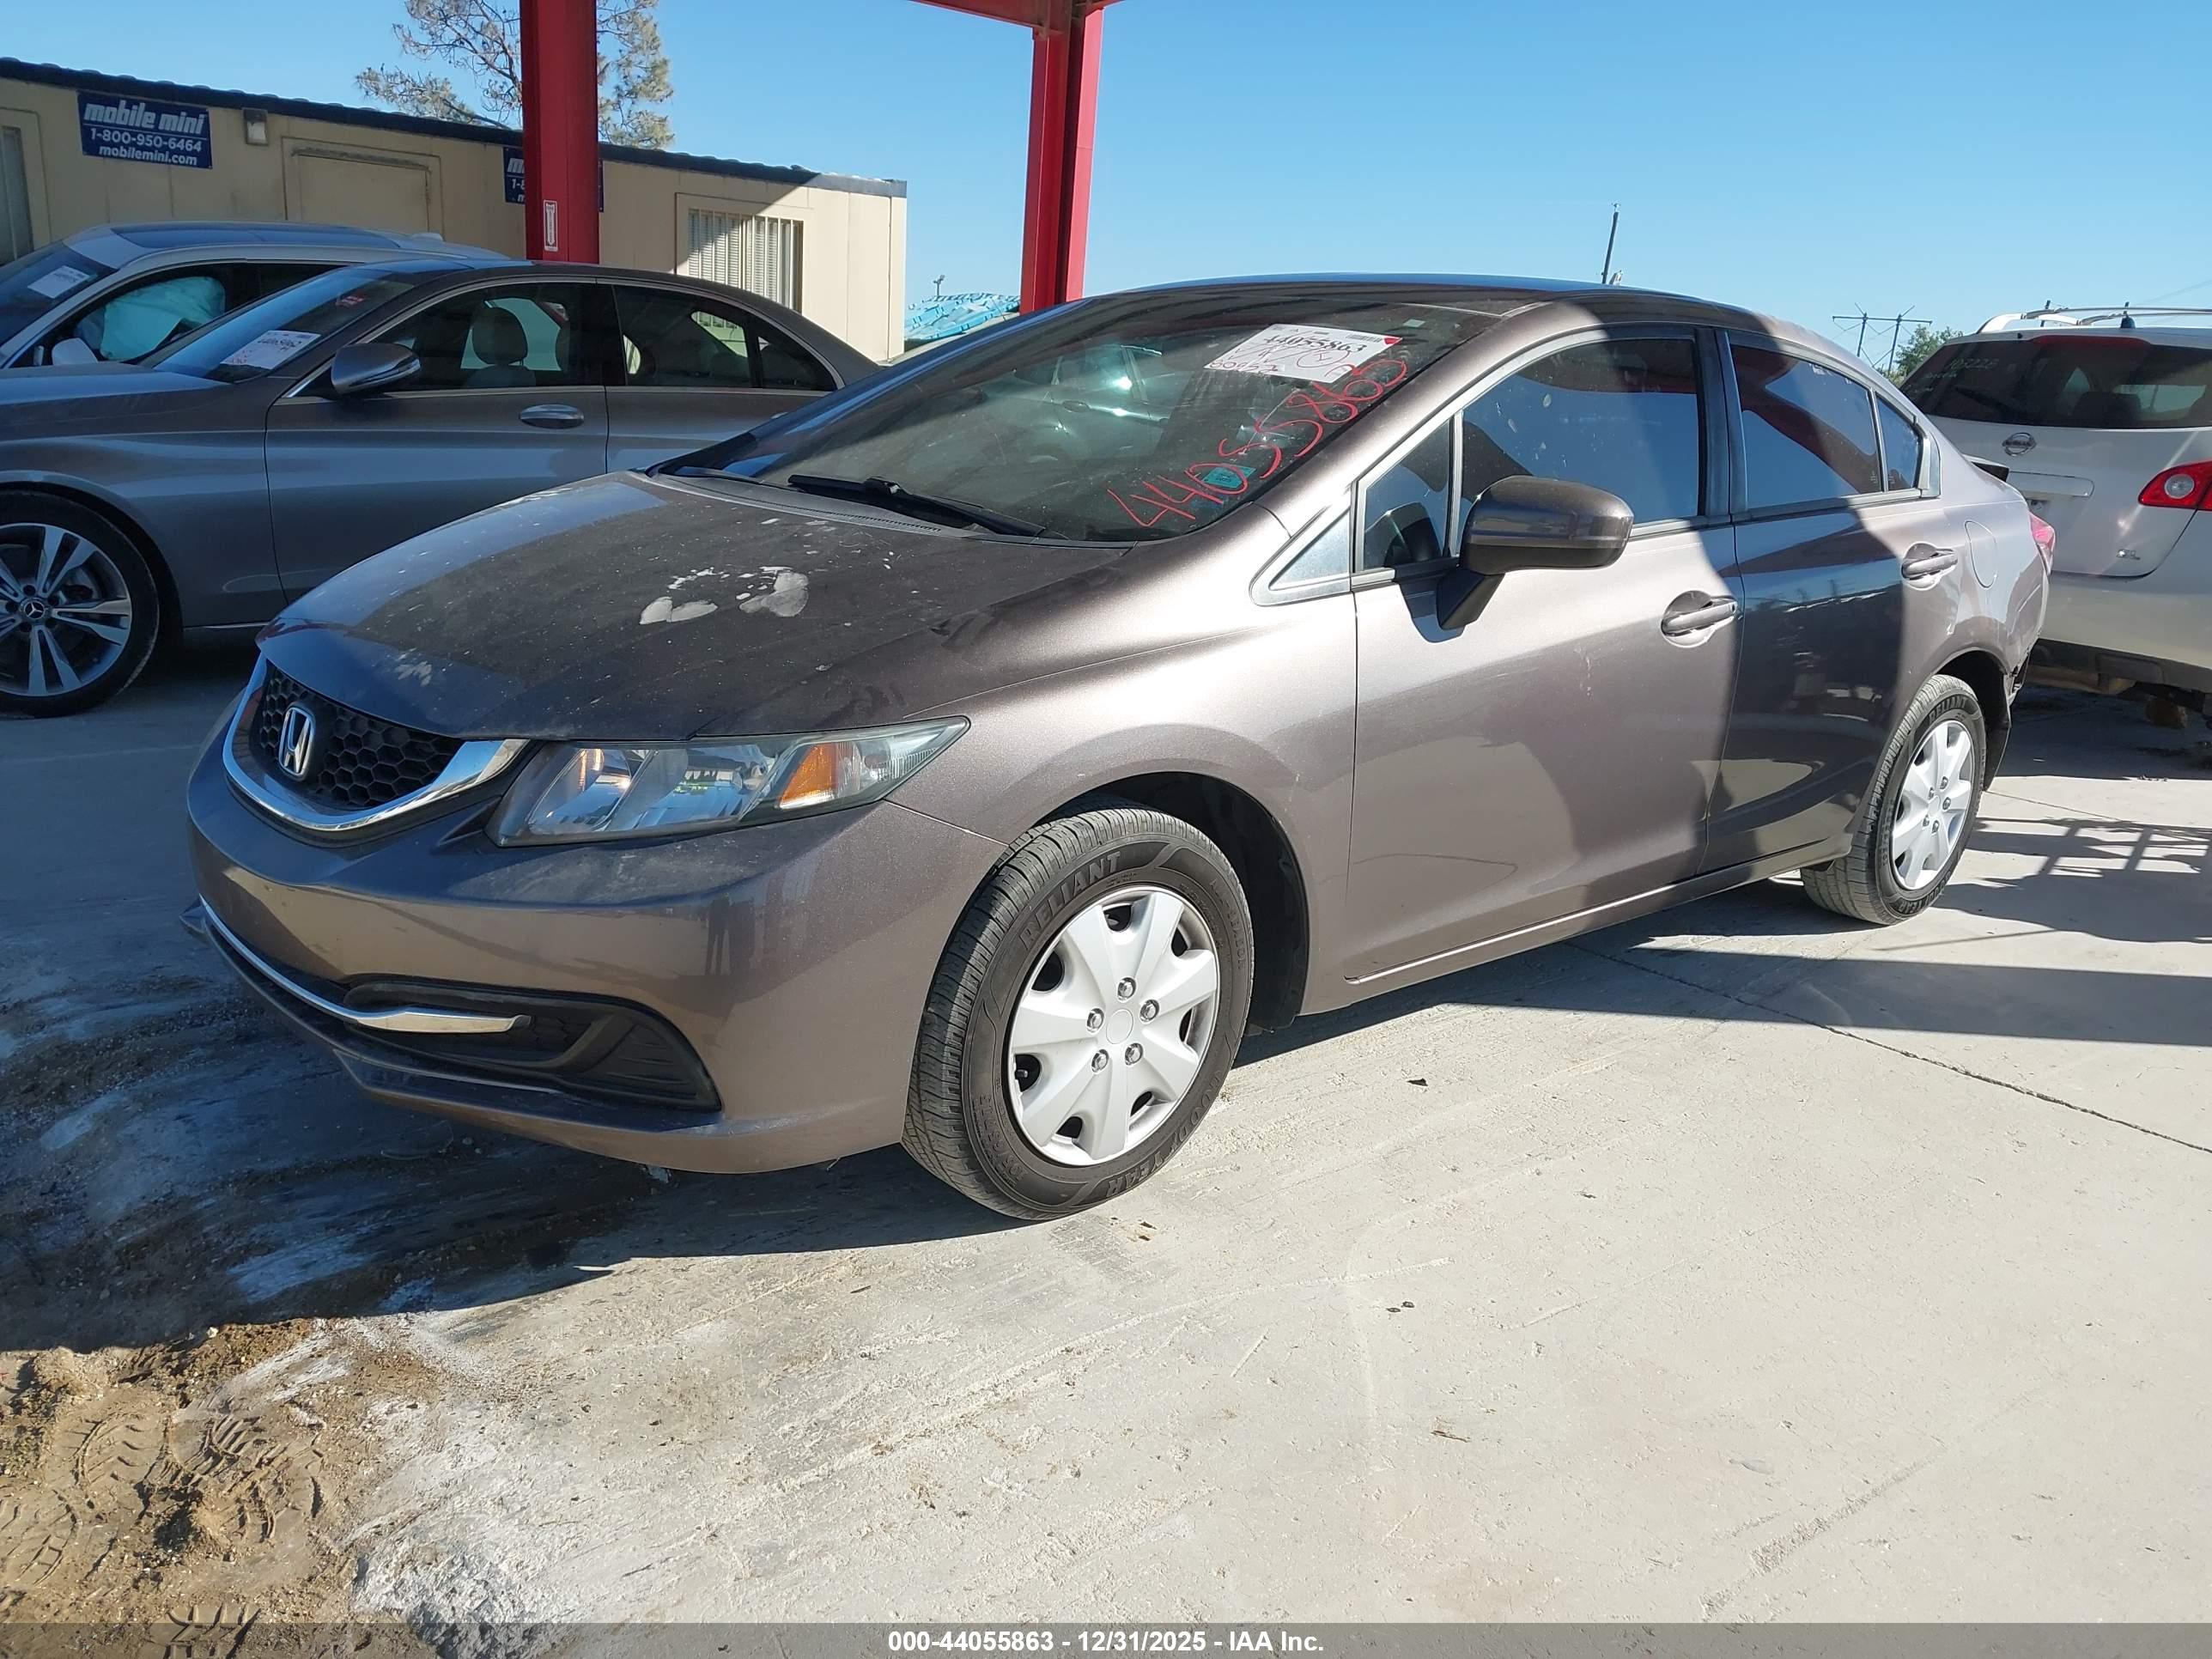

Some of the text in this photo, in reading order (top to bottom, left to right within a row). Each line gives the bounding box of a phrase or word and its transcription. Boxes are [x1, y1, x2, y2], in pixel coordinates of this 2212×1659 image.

[83, 100, 205, 134] mobile mini
[90, 128, 202, 152] 1-800-950-6464
[99, 146, 197, 165] mobilemini.com
[1264, 335, 1367, 353] 44055863
[1107, 358, 1408, 527] 44055863
[1018, 851, 1121, 951] RELIANT
